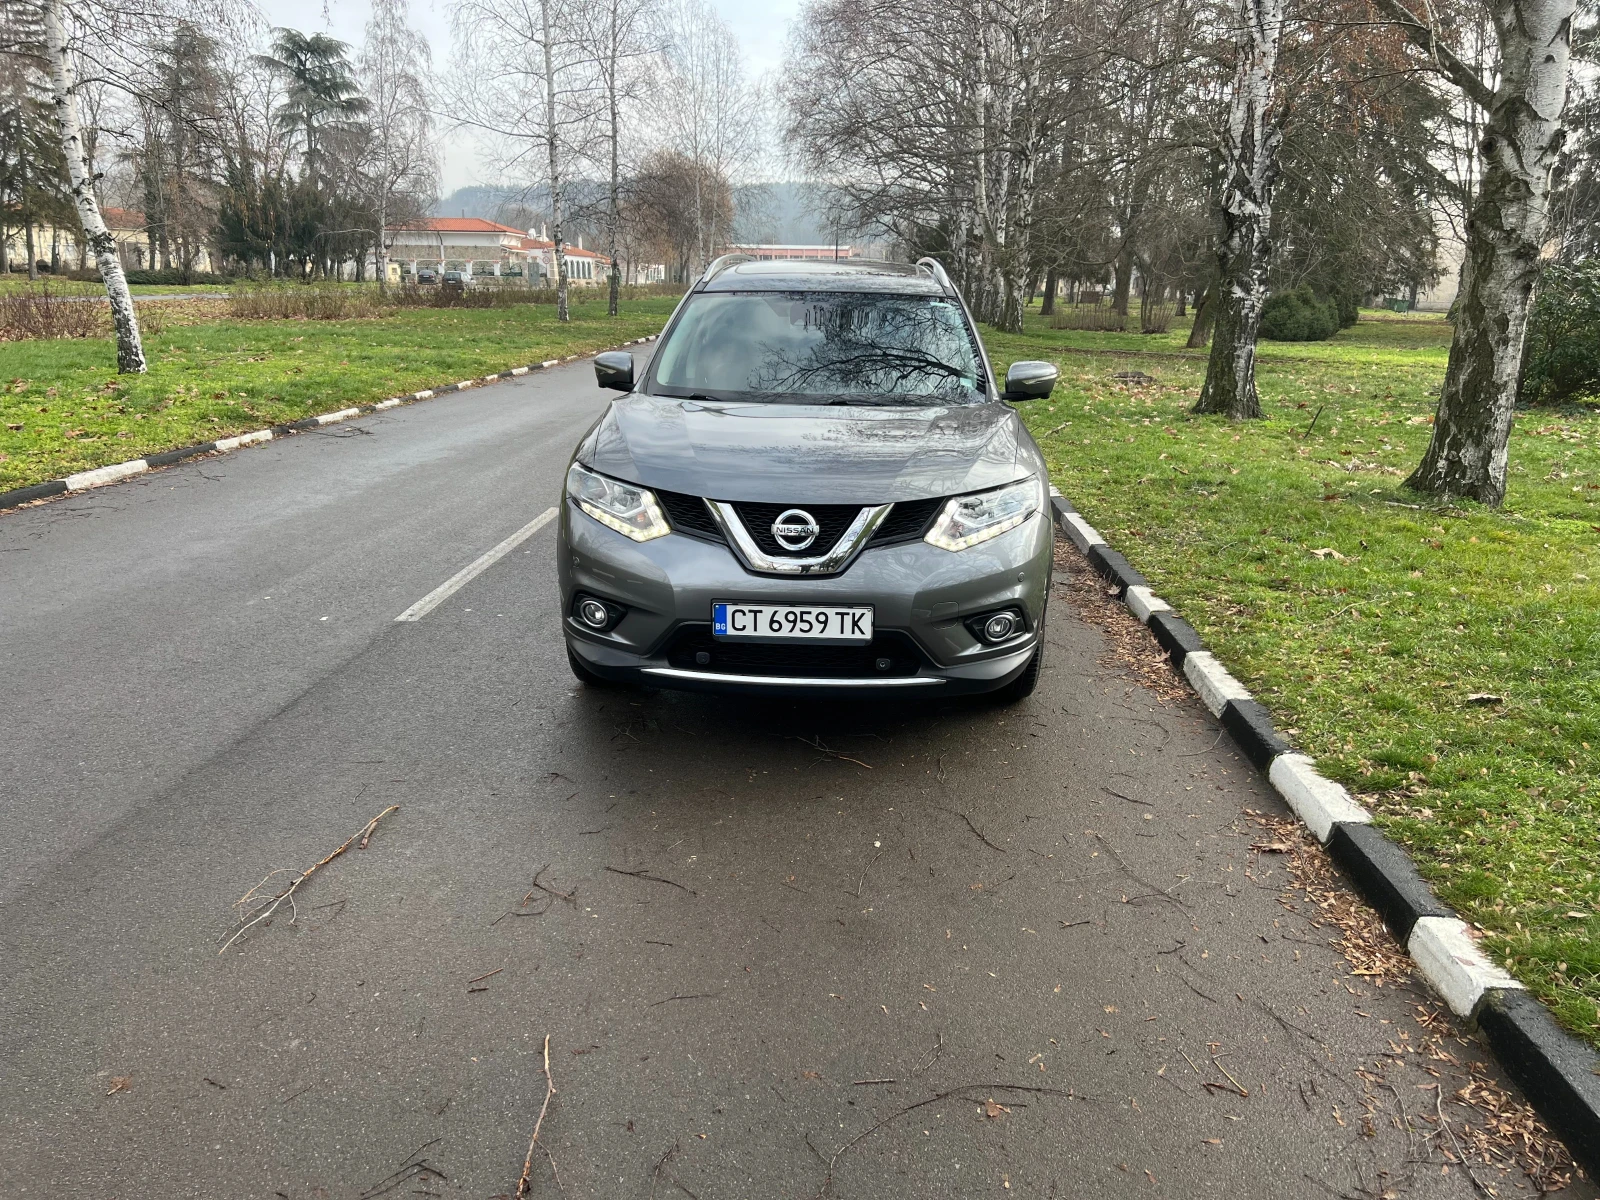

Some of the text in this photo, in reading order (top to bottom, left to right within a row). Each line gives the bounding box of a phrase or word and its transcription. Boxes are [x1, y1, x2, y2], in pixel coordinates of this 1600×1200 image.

[776, 526, 814, 535] NISSAN
[731, 609, 866, 635] CT 6959 TK
